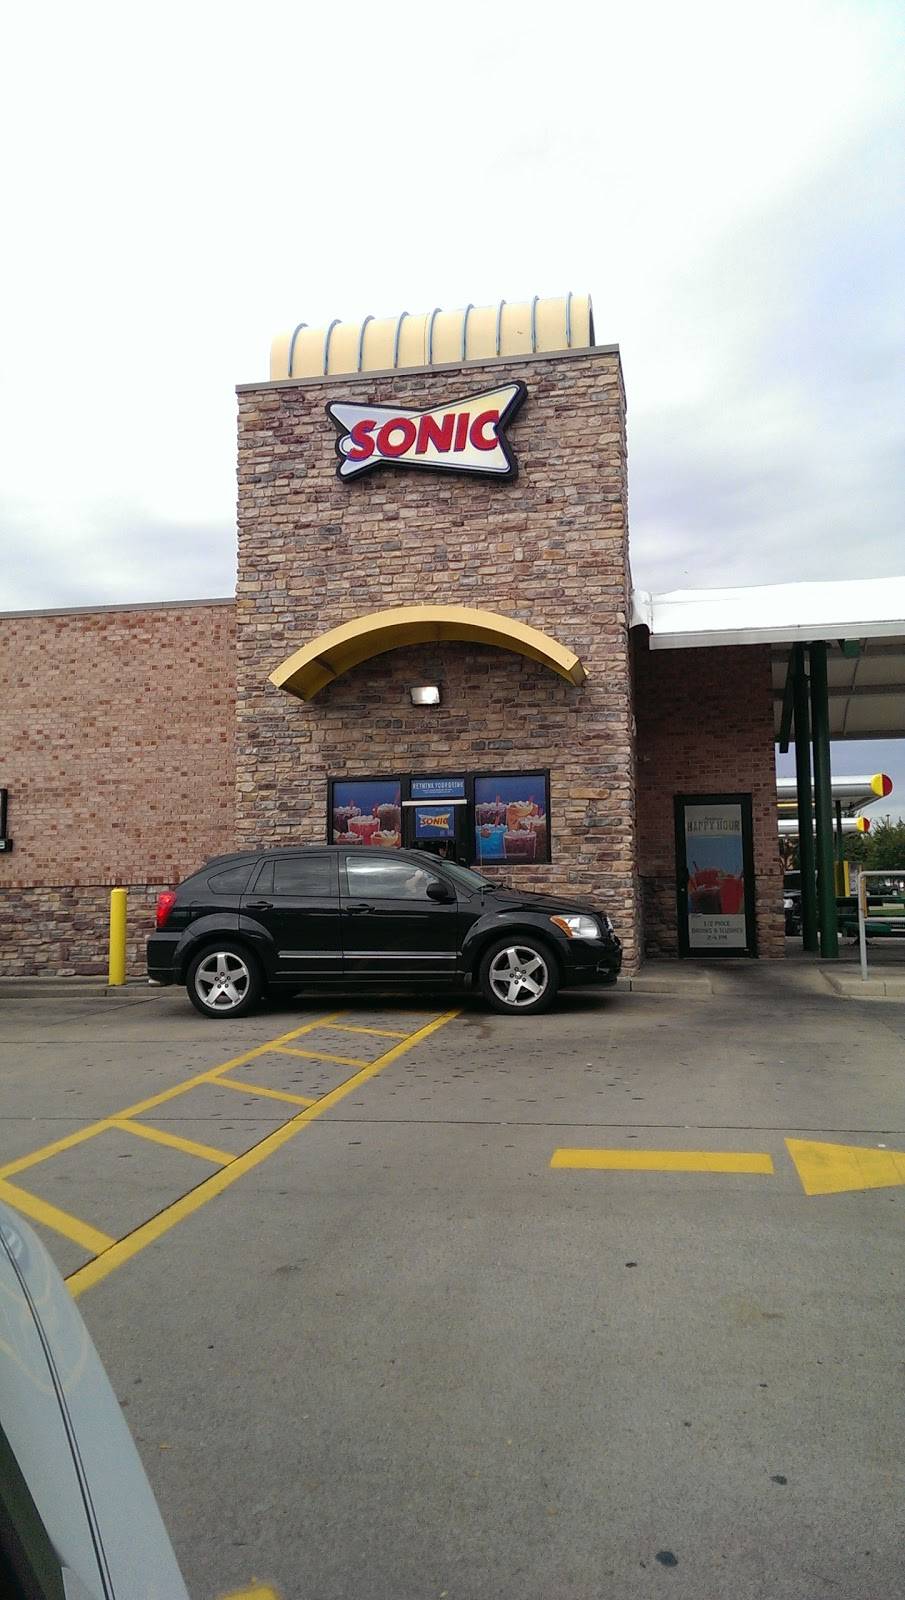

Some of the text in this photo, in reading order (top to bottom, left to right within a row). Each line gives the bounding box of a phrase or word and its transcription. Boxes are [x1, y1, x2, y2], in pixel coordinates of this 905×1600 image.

[347, 410, 500, 461] SONIC
[422, 817, 448, 825] SONIC
[687, 819, 740, 832] HAPPY HOUR
